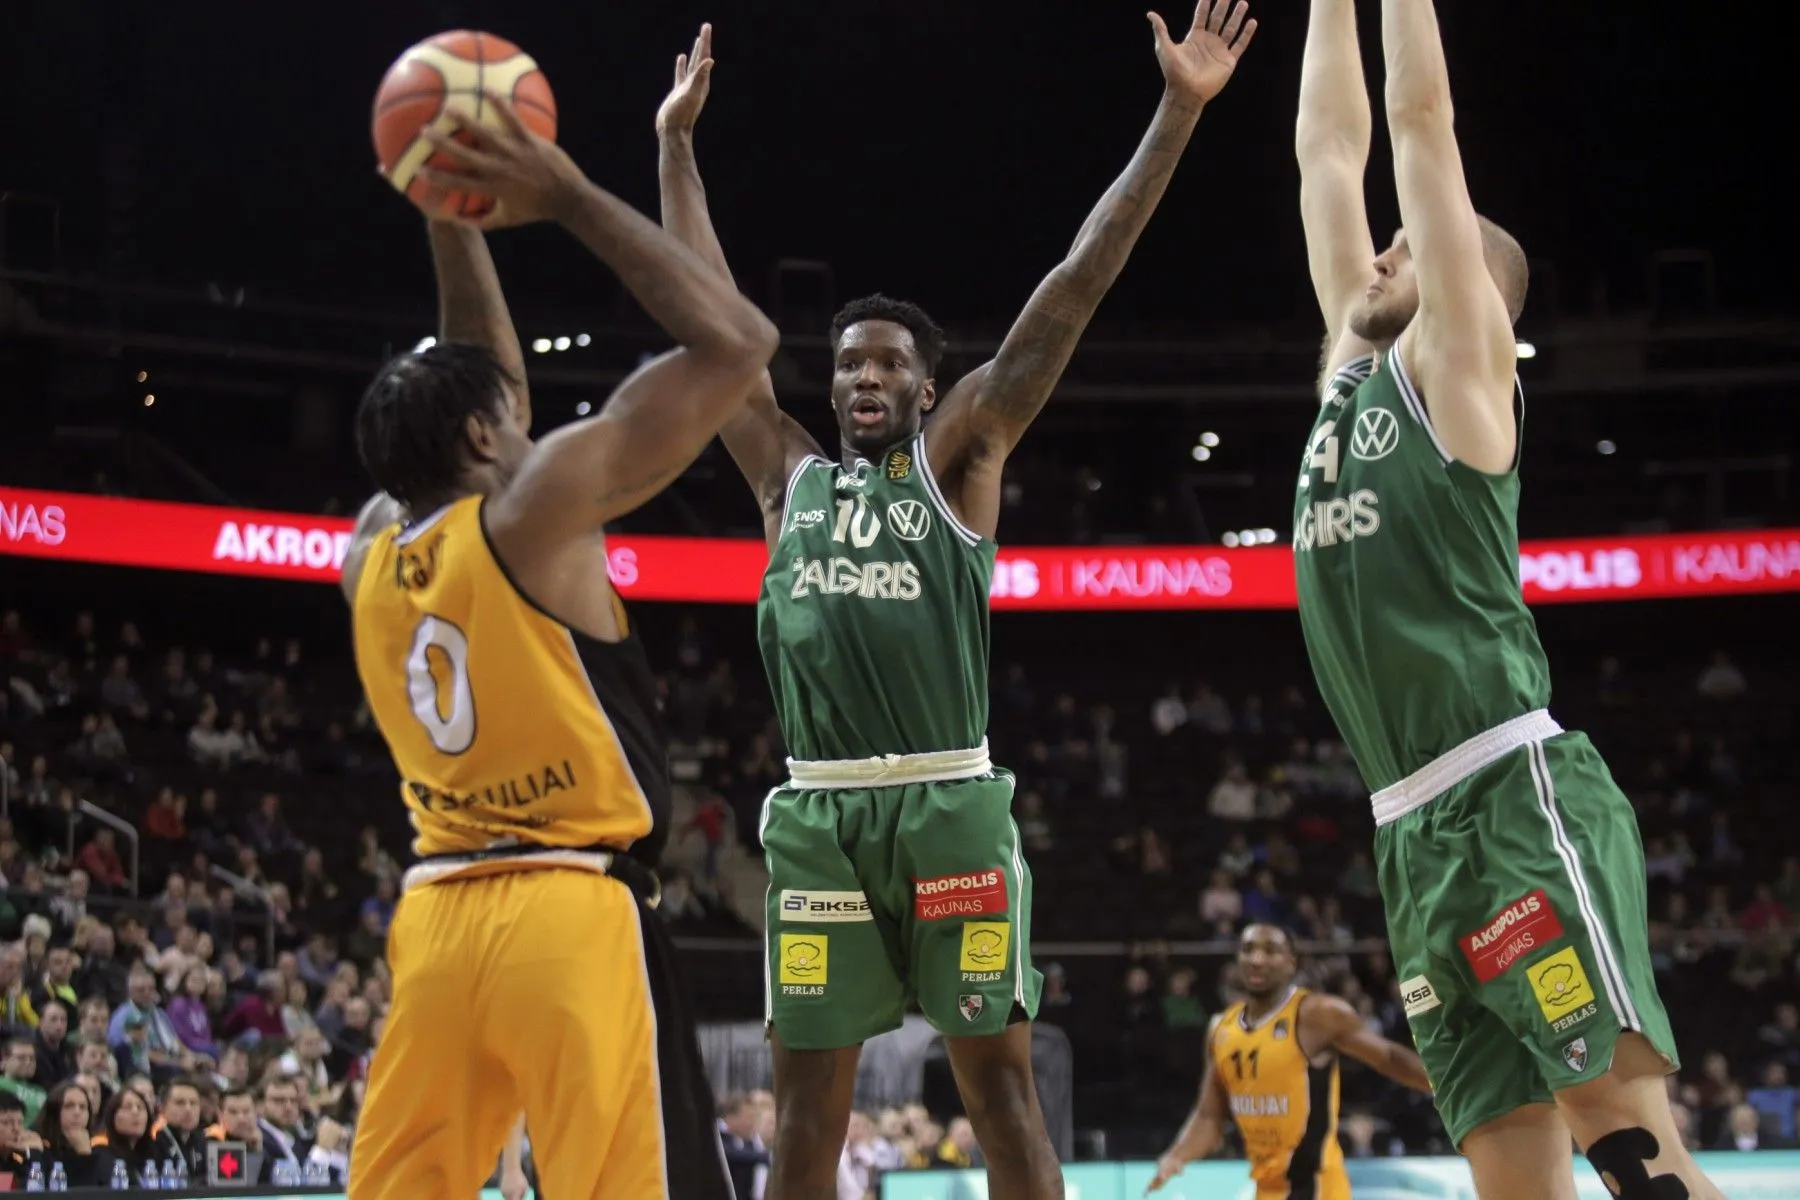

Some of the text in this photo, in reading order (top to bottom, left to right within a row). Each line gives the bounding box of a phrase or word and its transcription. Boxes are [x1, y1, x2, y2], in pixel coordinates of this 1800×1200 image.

[833, 494, 882, 549] 10
[1071, 557, 1232, 597] KAUNAS
[406, 615, 475, 756] 0
[916, 872, 998, 895] KROPOLIS
[923, 899, 983, 917] KAUNAS
[1496, 932, 1535, 969] KUNAS
[782, 985, 824, 995] PERLAS
[961, 971, 1001, 982] PERLAS
[1552, 1004, 1597, 1034] PERLAS
[1231, 1049, 1258, 1080] 11
